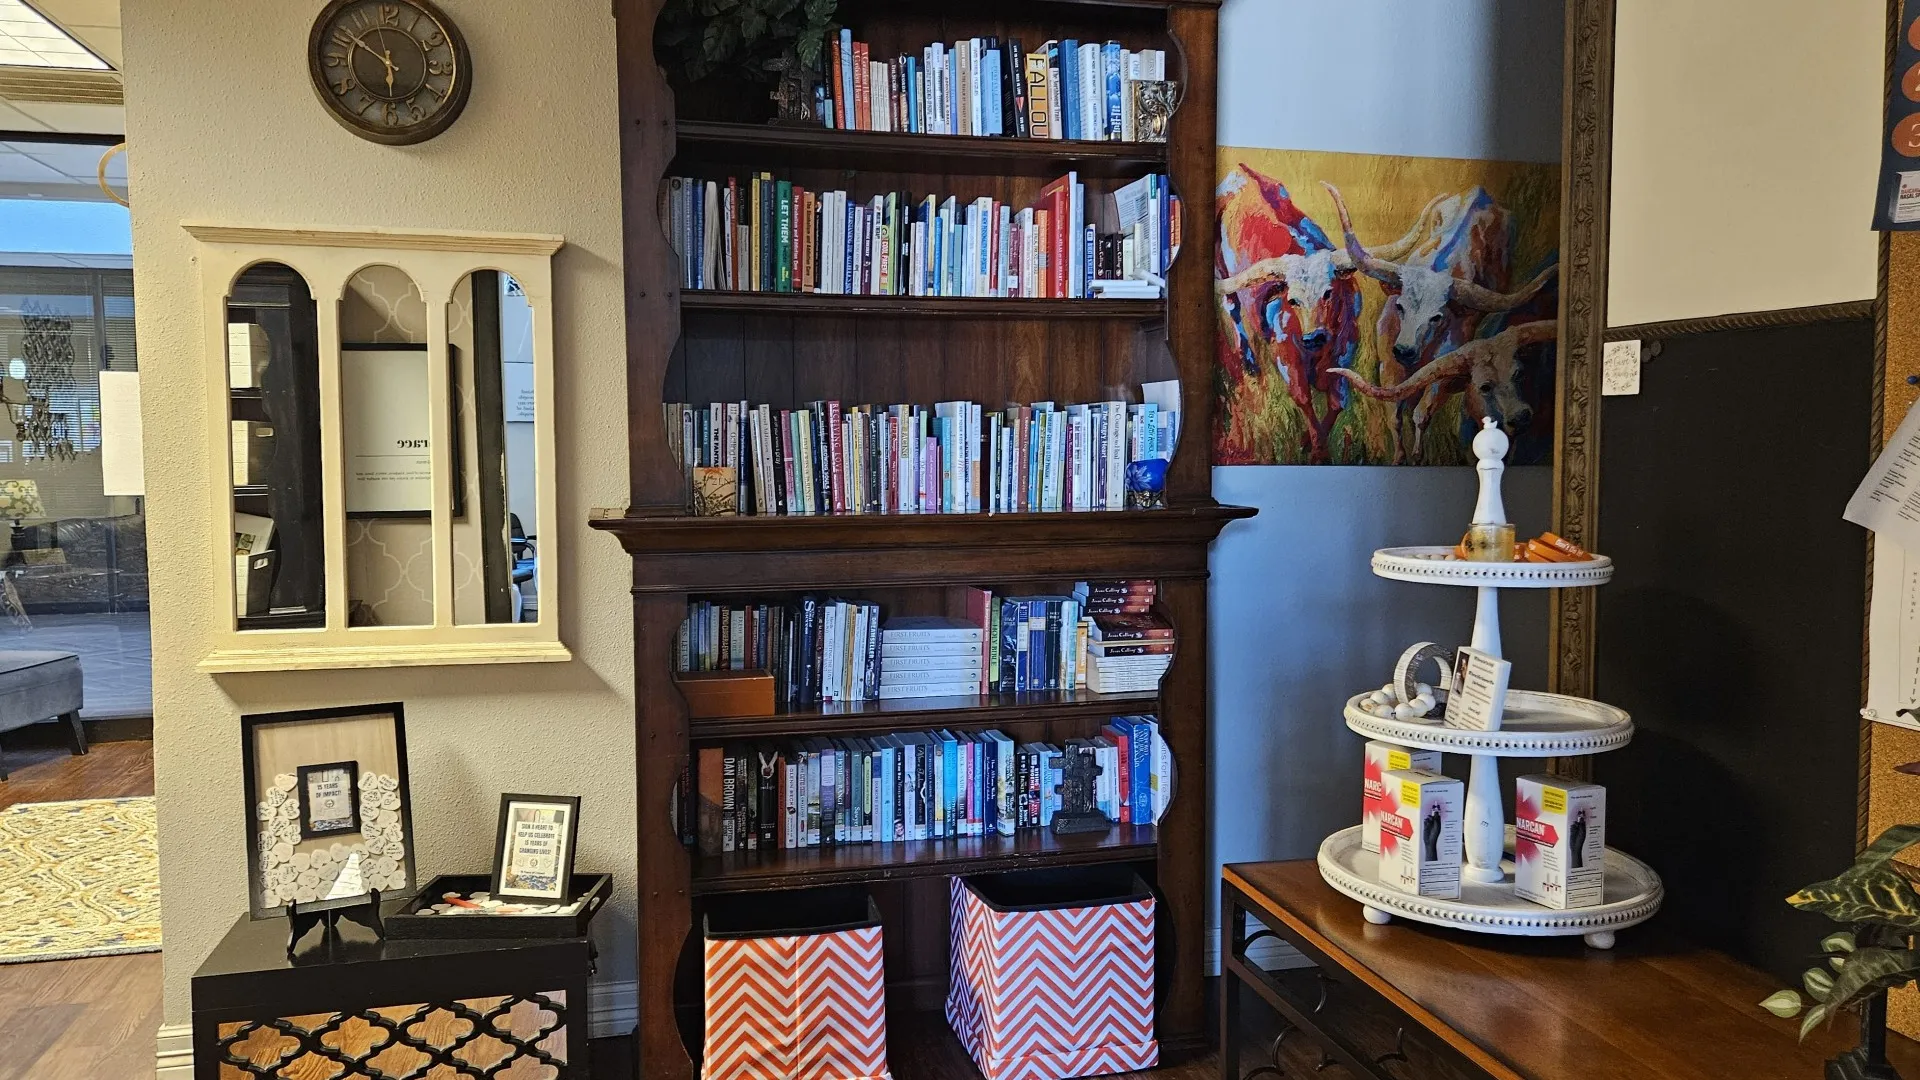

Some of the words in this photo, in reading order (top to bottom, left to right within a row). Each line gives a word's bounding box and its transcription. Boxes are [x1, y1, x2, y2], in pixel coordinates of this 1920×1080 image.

[378, 4, 399, 26] 12
[428, 60, 454, 76] 3
[382, 102, 399, 126] 6
[406, 97, 426, 121] 5
[781, 218, 789, 243] THEM
[832, 403, 840, 447] RECEIVING
[1113, 413, 1122, 439] Courage
[723, 757, 735, 776] DAN
[723, 778, 735, 810] BROWN
[1380, 810, 1403, 829] NARCAN
[1516, 817, 1546, 836] NARCAN
